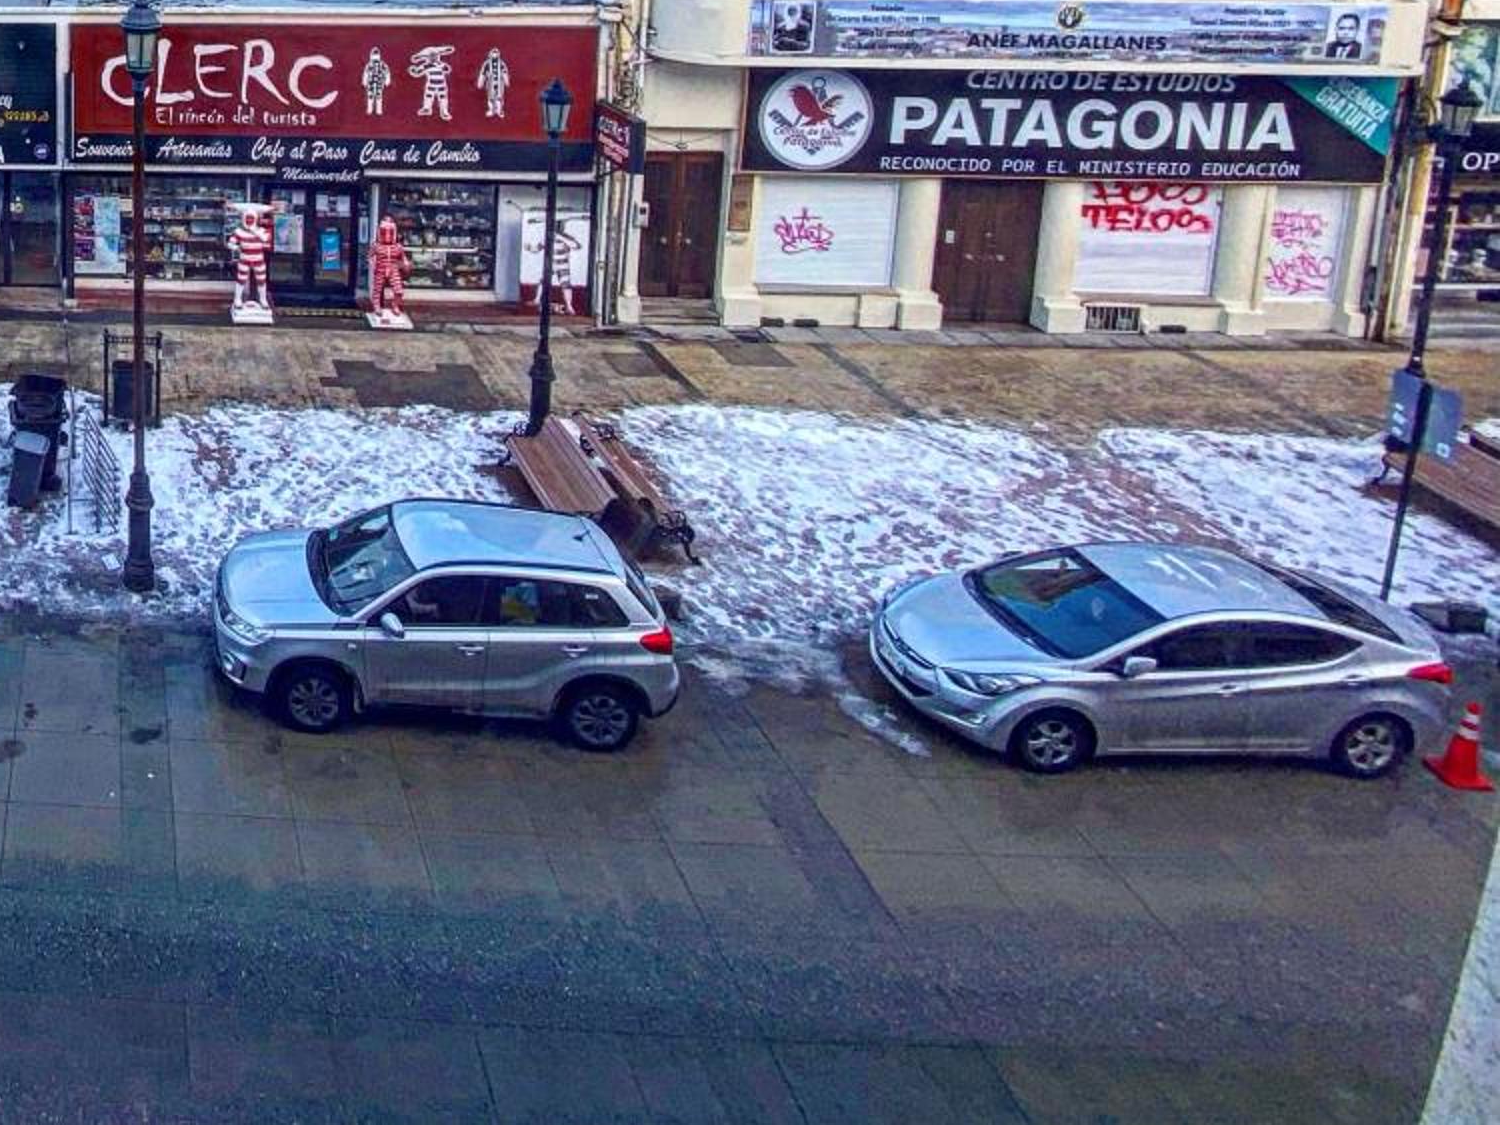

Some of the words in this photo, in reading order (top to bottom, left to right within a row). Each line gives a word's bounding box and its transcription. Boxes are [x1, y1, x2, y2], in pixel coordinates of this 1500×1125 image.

[966, 34, 1019, 48] ANEF
[1025, 35, 1168, 51] MAGALLANES
[101, 38, 338, 108] CLERC
[967, 70, 1070, 90] CENTRO
[1073, 71, 1109, 91] DE
[1112, 72, 1237, 93] ESTUDIOS
[156, 107, 173, 124] El
[179, 108, 225, 124] rincón
[233, 107, 255, 124] del
[263, 110, 316, 125] turista
[888, 96, 1296, 151] PATAGONIA
[1315, 86, 1379, 140] GRATUITA
[289, 140, 307, 160] al
[311, 140, 348, 162] Paso
[359, 140, 398, 165] Casa
[403, 144, 421, 163] de
[426, 140, 481, 166] Cambio
[1462, 152, 1500, 171] OP
[880, 156, 992, 172] RECONOCIDO
[1002, 158, 1036, 173] POR
[1046, 160, 1068, 174] EL
[1079, 159, 1191, 175] MINISTERIO
[1201, 160, 1301, 177] EDUCACIÓN
